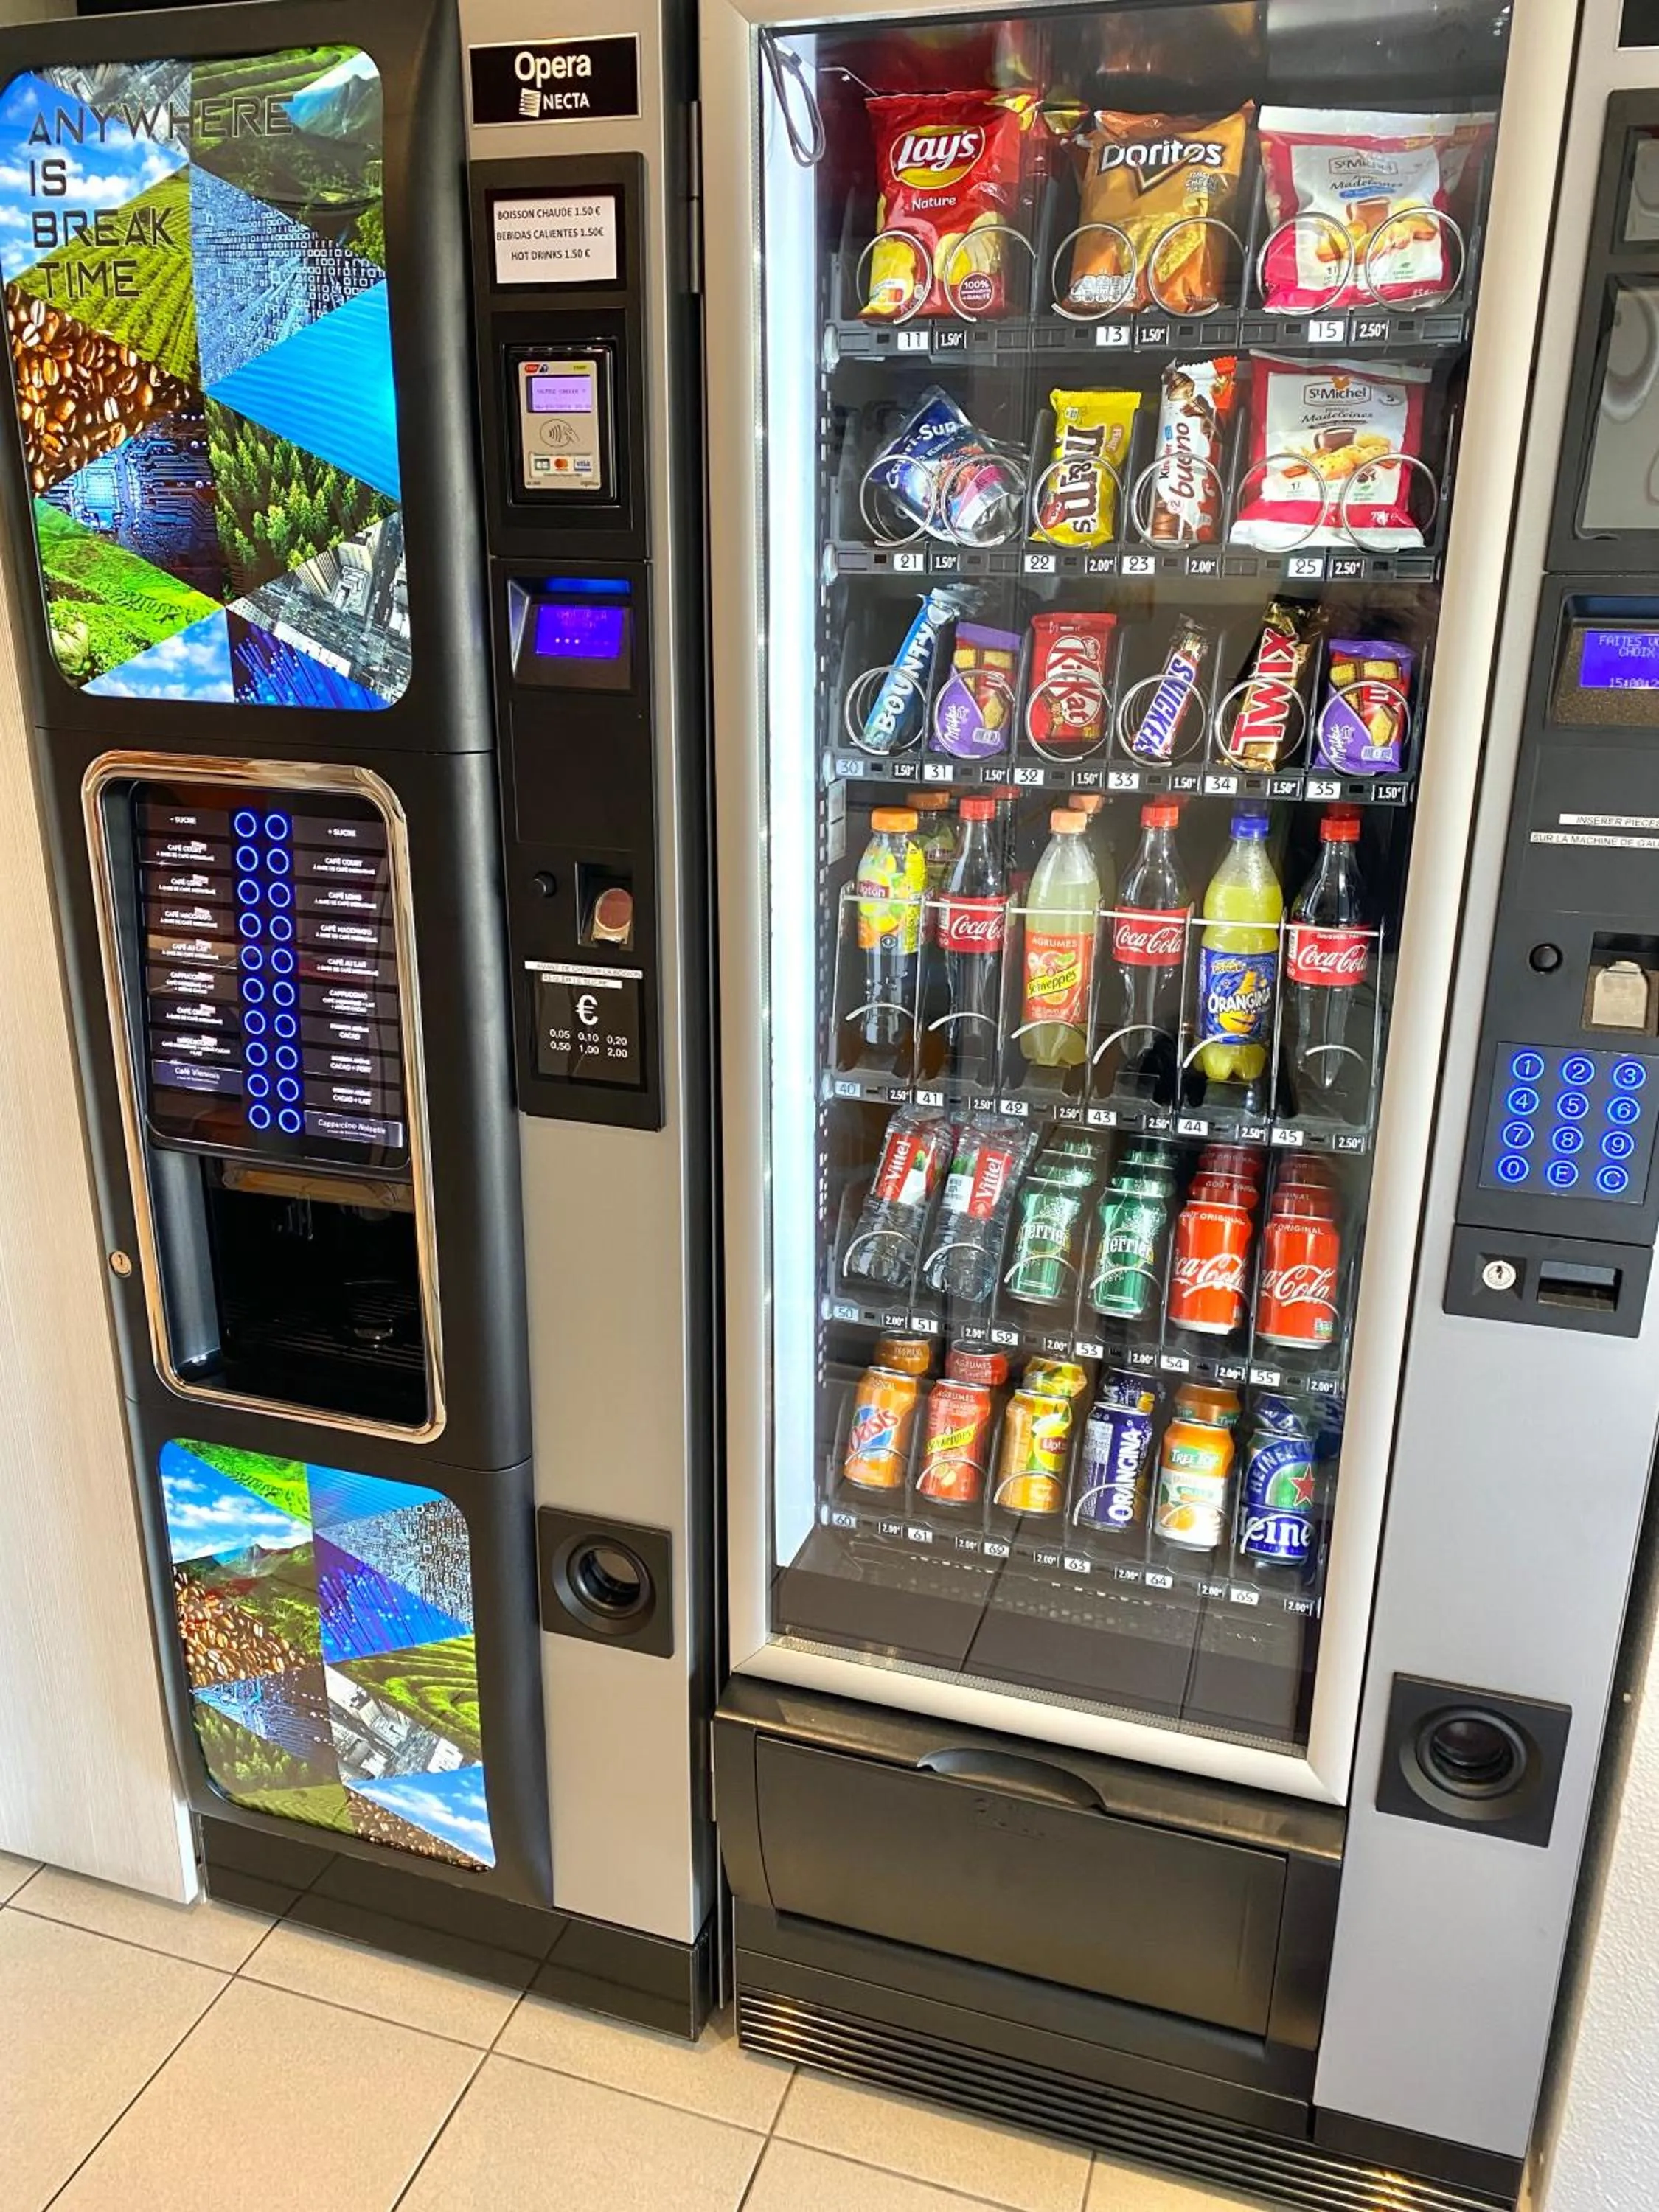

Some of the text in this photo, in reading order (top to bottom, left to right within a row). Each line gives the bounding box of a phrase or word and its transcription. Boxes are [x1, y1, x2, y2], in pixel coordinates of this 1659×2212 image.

[515, 51, 592, 88] Opera
[543, 92, 590, 110] NECTA
[28, 95, 293, 146] ANYWHERE
[897, 130, 978, 171] Lay's
[1101, 140, 1222, 171] Doritos
[30, 159, 66, 196] IS
[912, 196, 956, 211] Nature
[498, 209, 535, 220] BOISSON
[536, 207, 572, 218] CHAUDE
[574, 206, 593, 216] 1.50
[32, 208, 175, 248] BREAK
[496, 227, 604, 240] BEBIDAS CALIENTES 1.50€
[511, 250, 529, 260] HOT
[532, 249, 563, 260] DRINKS
[564, 249, 582, 258] 1.50
[37, 260, 140, 299] TIME
[964, 280, 990, 289] 100%
[1105, 327, 1121, 342] 13
[1317, 324, 1336, 338] 15
[906, 333, 922, 347] 11
[1169, 422, 1194, 498] bueno
[901, 556, 917, 568] 21
[1030, 556, 1049, 570] 22
[1129, 557, 1148, 571] 23
[1295, 560, 1316, 574] 25
[1599, 635, 1641, 646] FAITES
[1618, 647, 1655, 658] CHOIX
[877, 622, 936, 734] BOUNTY
[1231, 628, 1299, 754] TWIX
[841, 762, 859, 773] 30
[931, 766, 947, 779] 31
[1020, 770, 1038, 782] 32
[1114, 774, 1133, 786] 33
[1211, 778, 1231, 791] 34
[1315, 782, 1333, 796] 35
[1576, 816, 1621, 826] INSERER
[1571, 835, 1617, 845] MACHINE
[1033, 936, 1077, 947] AGRUMES
[1116, 924, 1183, 955] Coca-Cola
[1298, 943, 1368, 973] Coca-Cola
[1208, 987, 1272, 1015] ORANGINA
[575, 995, 598, 1026] €
[175, 1067, 190, 1075] Café
[1572, 1063, 1585, 1079] 2
[1623, 1068, 1637, 1084] 3
[840, 1084, 855, 1094] 40
[923, 1095, 938, 1105] 41
[1516, 1093, 1528, 1109] 4
[1566, 1098, 1580, 1113] 5
[1006, 1103, 1023, 1113] 42
[1618, 1102, 1630, 1119] 6
[1093, 1112, 1111, 1123] 43
[1183, 1121, 1202, 1132] 44
[1279, 1130, 1297, 1142] 45
[1513, 1127, 1523, 1142] 7
[1561, 1132, 1574, 1147] 8
[1611, 1137, 1625, 1153] 9
[886, 1140, 911, 1181] Vittel
[1507, 1161, 1520, 1176] 0
[1556, 1166, 1569, 1182] E
[976, 1156, 1003, 1200] Vittel
[1604, 1170, 1621, 1187] C
[1200, 1212, 1245, 1225] ORIGINAL
[1020, 1223, 1065, 1246] errie
[1277, 1223, 1325, 1236] ORIGINAL
[1104, 1237, 1149, 1258] errie
[1175, 1253, 1246, 1289] ca-Cola
[918, 1319, 932, 1330] 51
[997, 1332, 1012, 1342] 52
[1082, 1345, 1097, 1355] 53
[1166, 1357, 1183, 1368] 54
[1257, 1372, 1273, 1382] 55
[1107, 1428, 1141, 1522] ORANGINA
[914, 1531, 927, 1540] 61
[1070, 1559, 1085, 1571] 63
